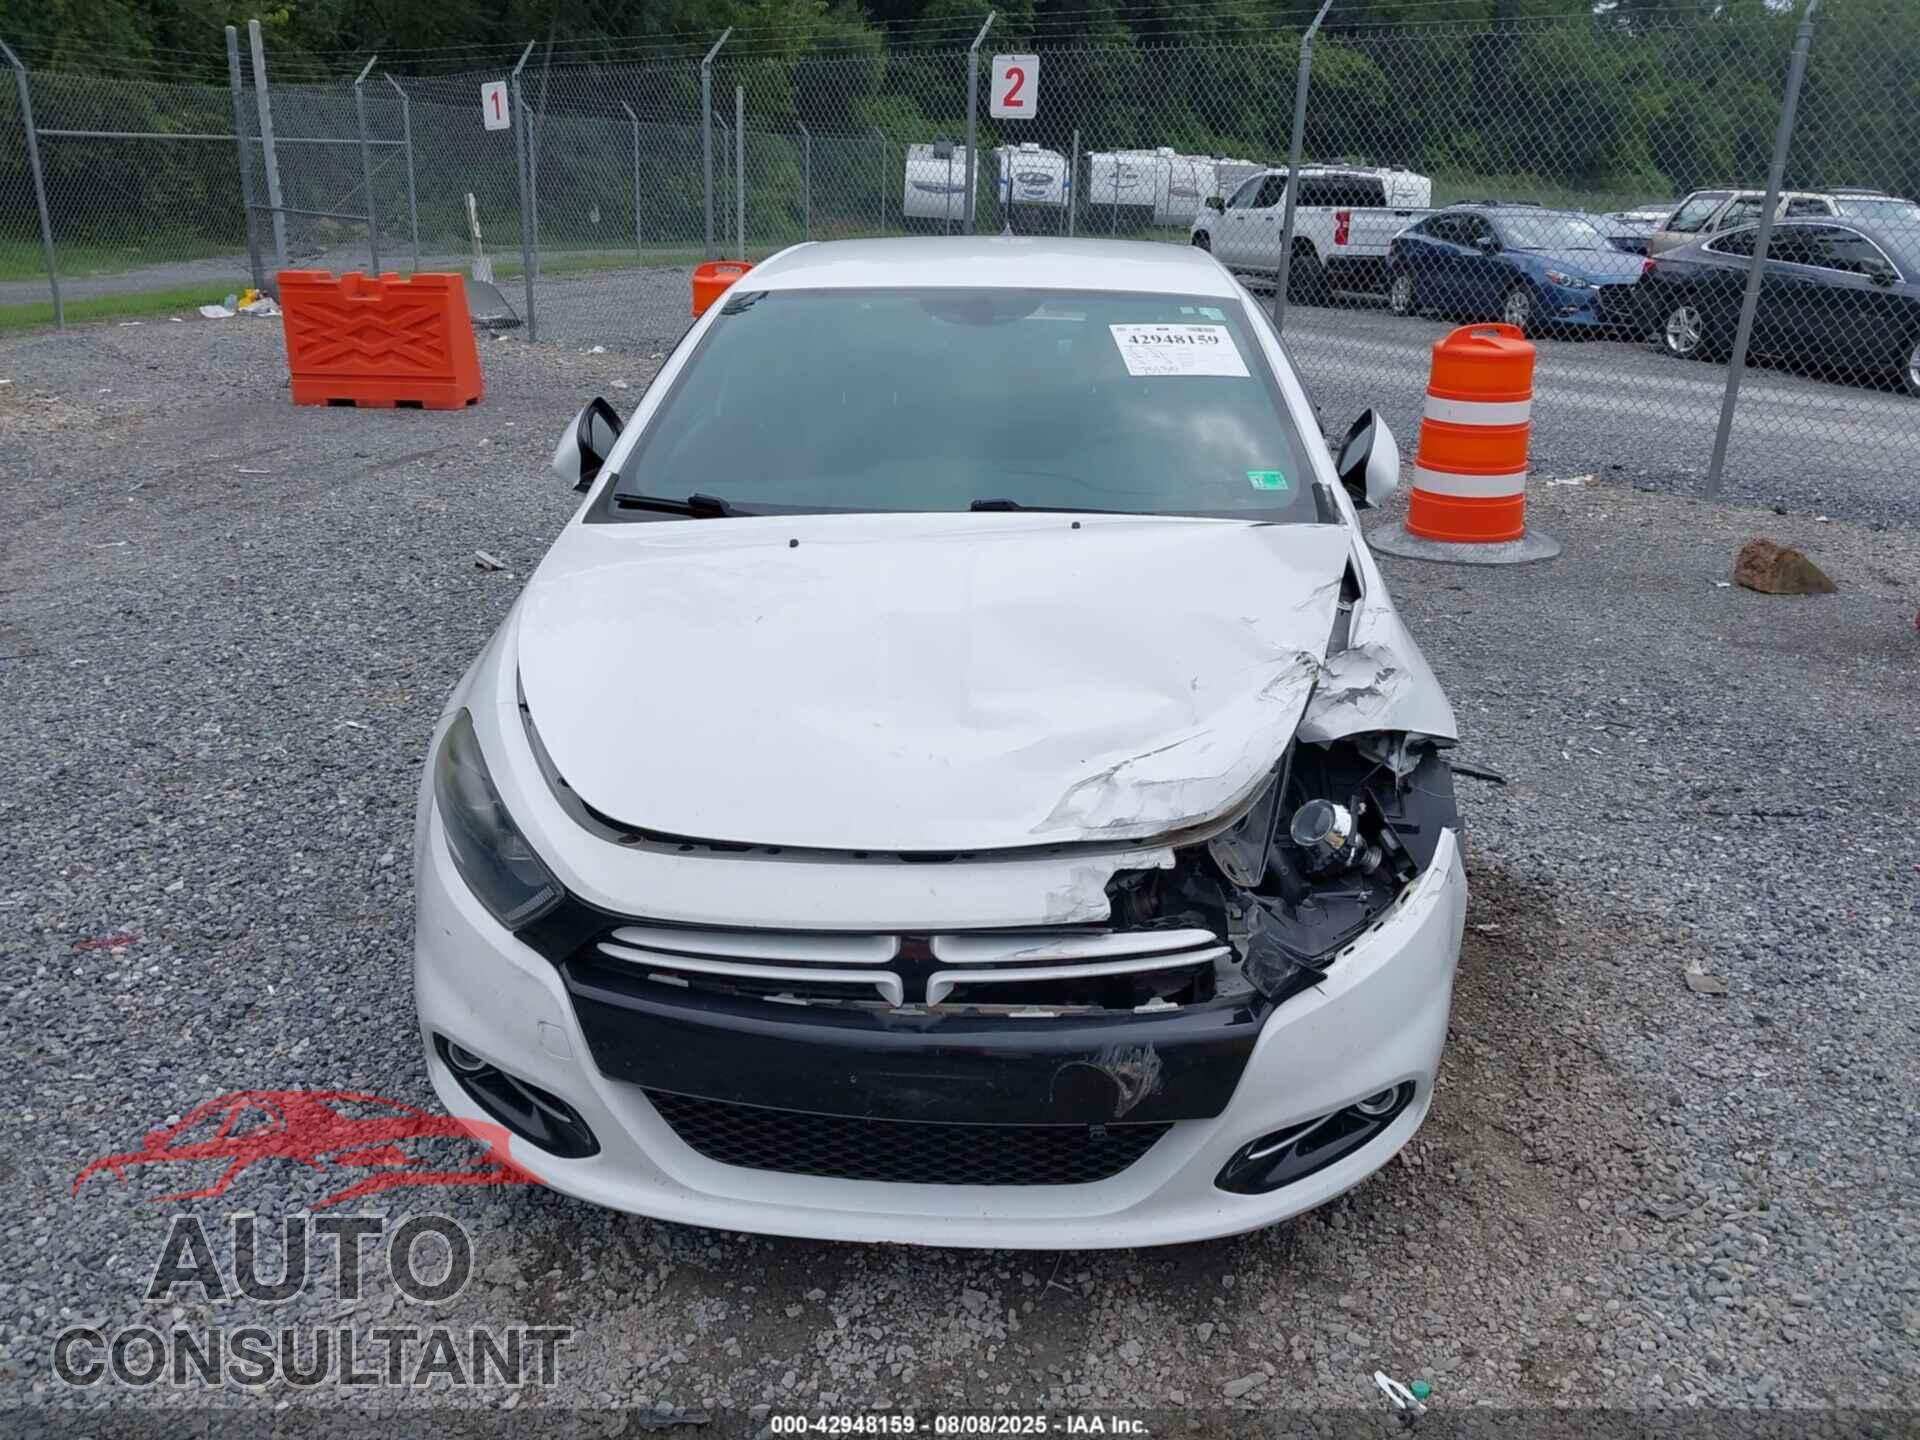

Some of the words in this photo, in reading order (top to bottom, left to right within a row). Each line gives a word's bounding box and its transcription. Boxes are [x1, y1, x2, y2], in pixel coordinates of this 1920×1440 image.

[1003, 66, 1024, 107] 2
[491, 91, 500, 120] 1
[1128, 334, 1219, 344] 42948159
